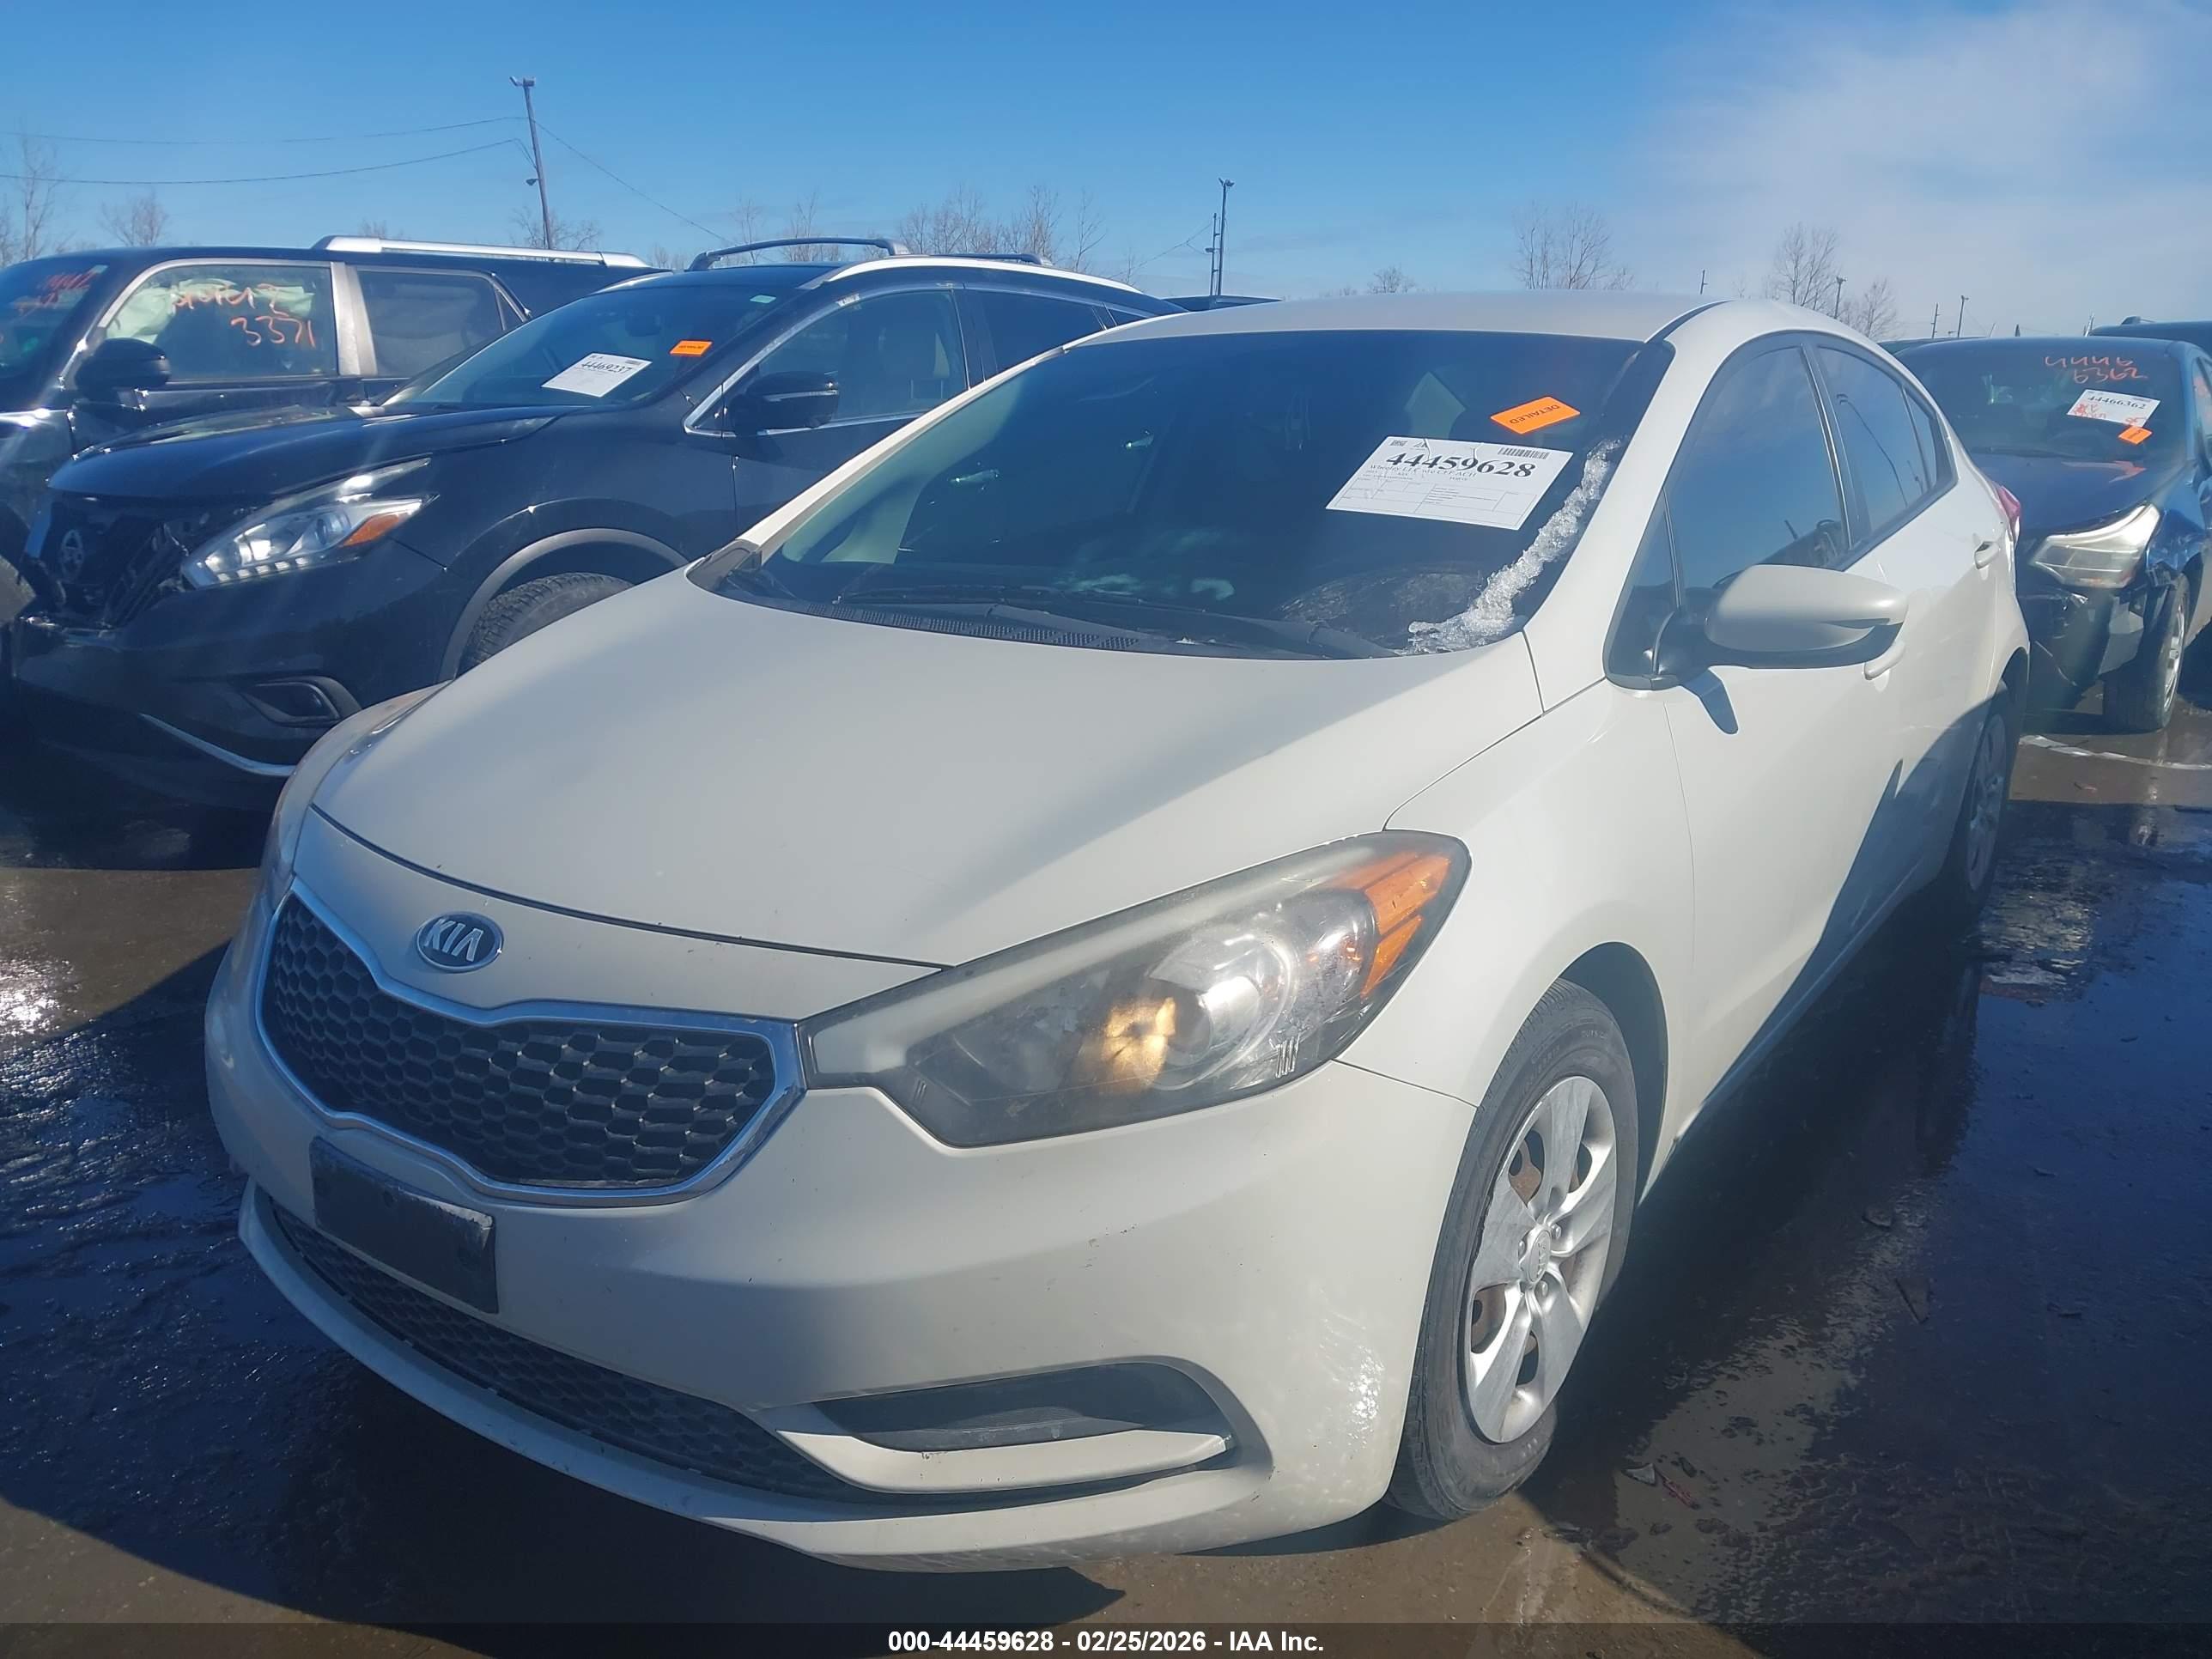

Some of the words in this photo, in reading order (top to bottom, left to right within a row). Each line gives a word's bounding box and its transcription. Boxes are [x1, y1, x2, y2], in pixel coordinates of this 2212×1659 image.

[230, 315, 317, 348] 3371
[580, 361, 633, 374] 44469237
[2074, 367, 2148, 384] 6362
[2087, 396, 2146, 410] 44466362
[1509, 404, 1560, 424] DETAILED
[1385, 452, 1536, 478] 44459628
[423, 918, 484, 963] KIA
